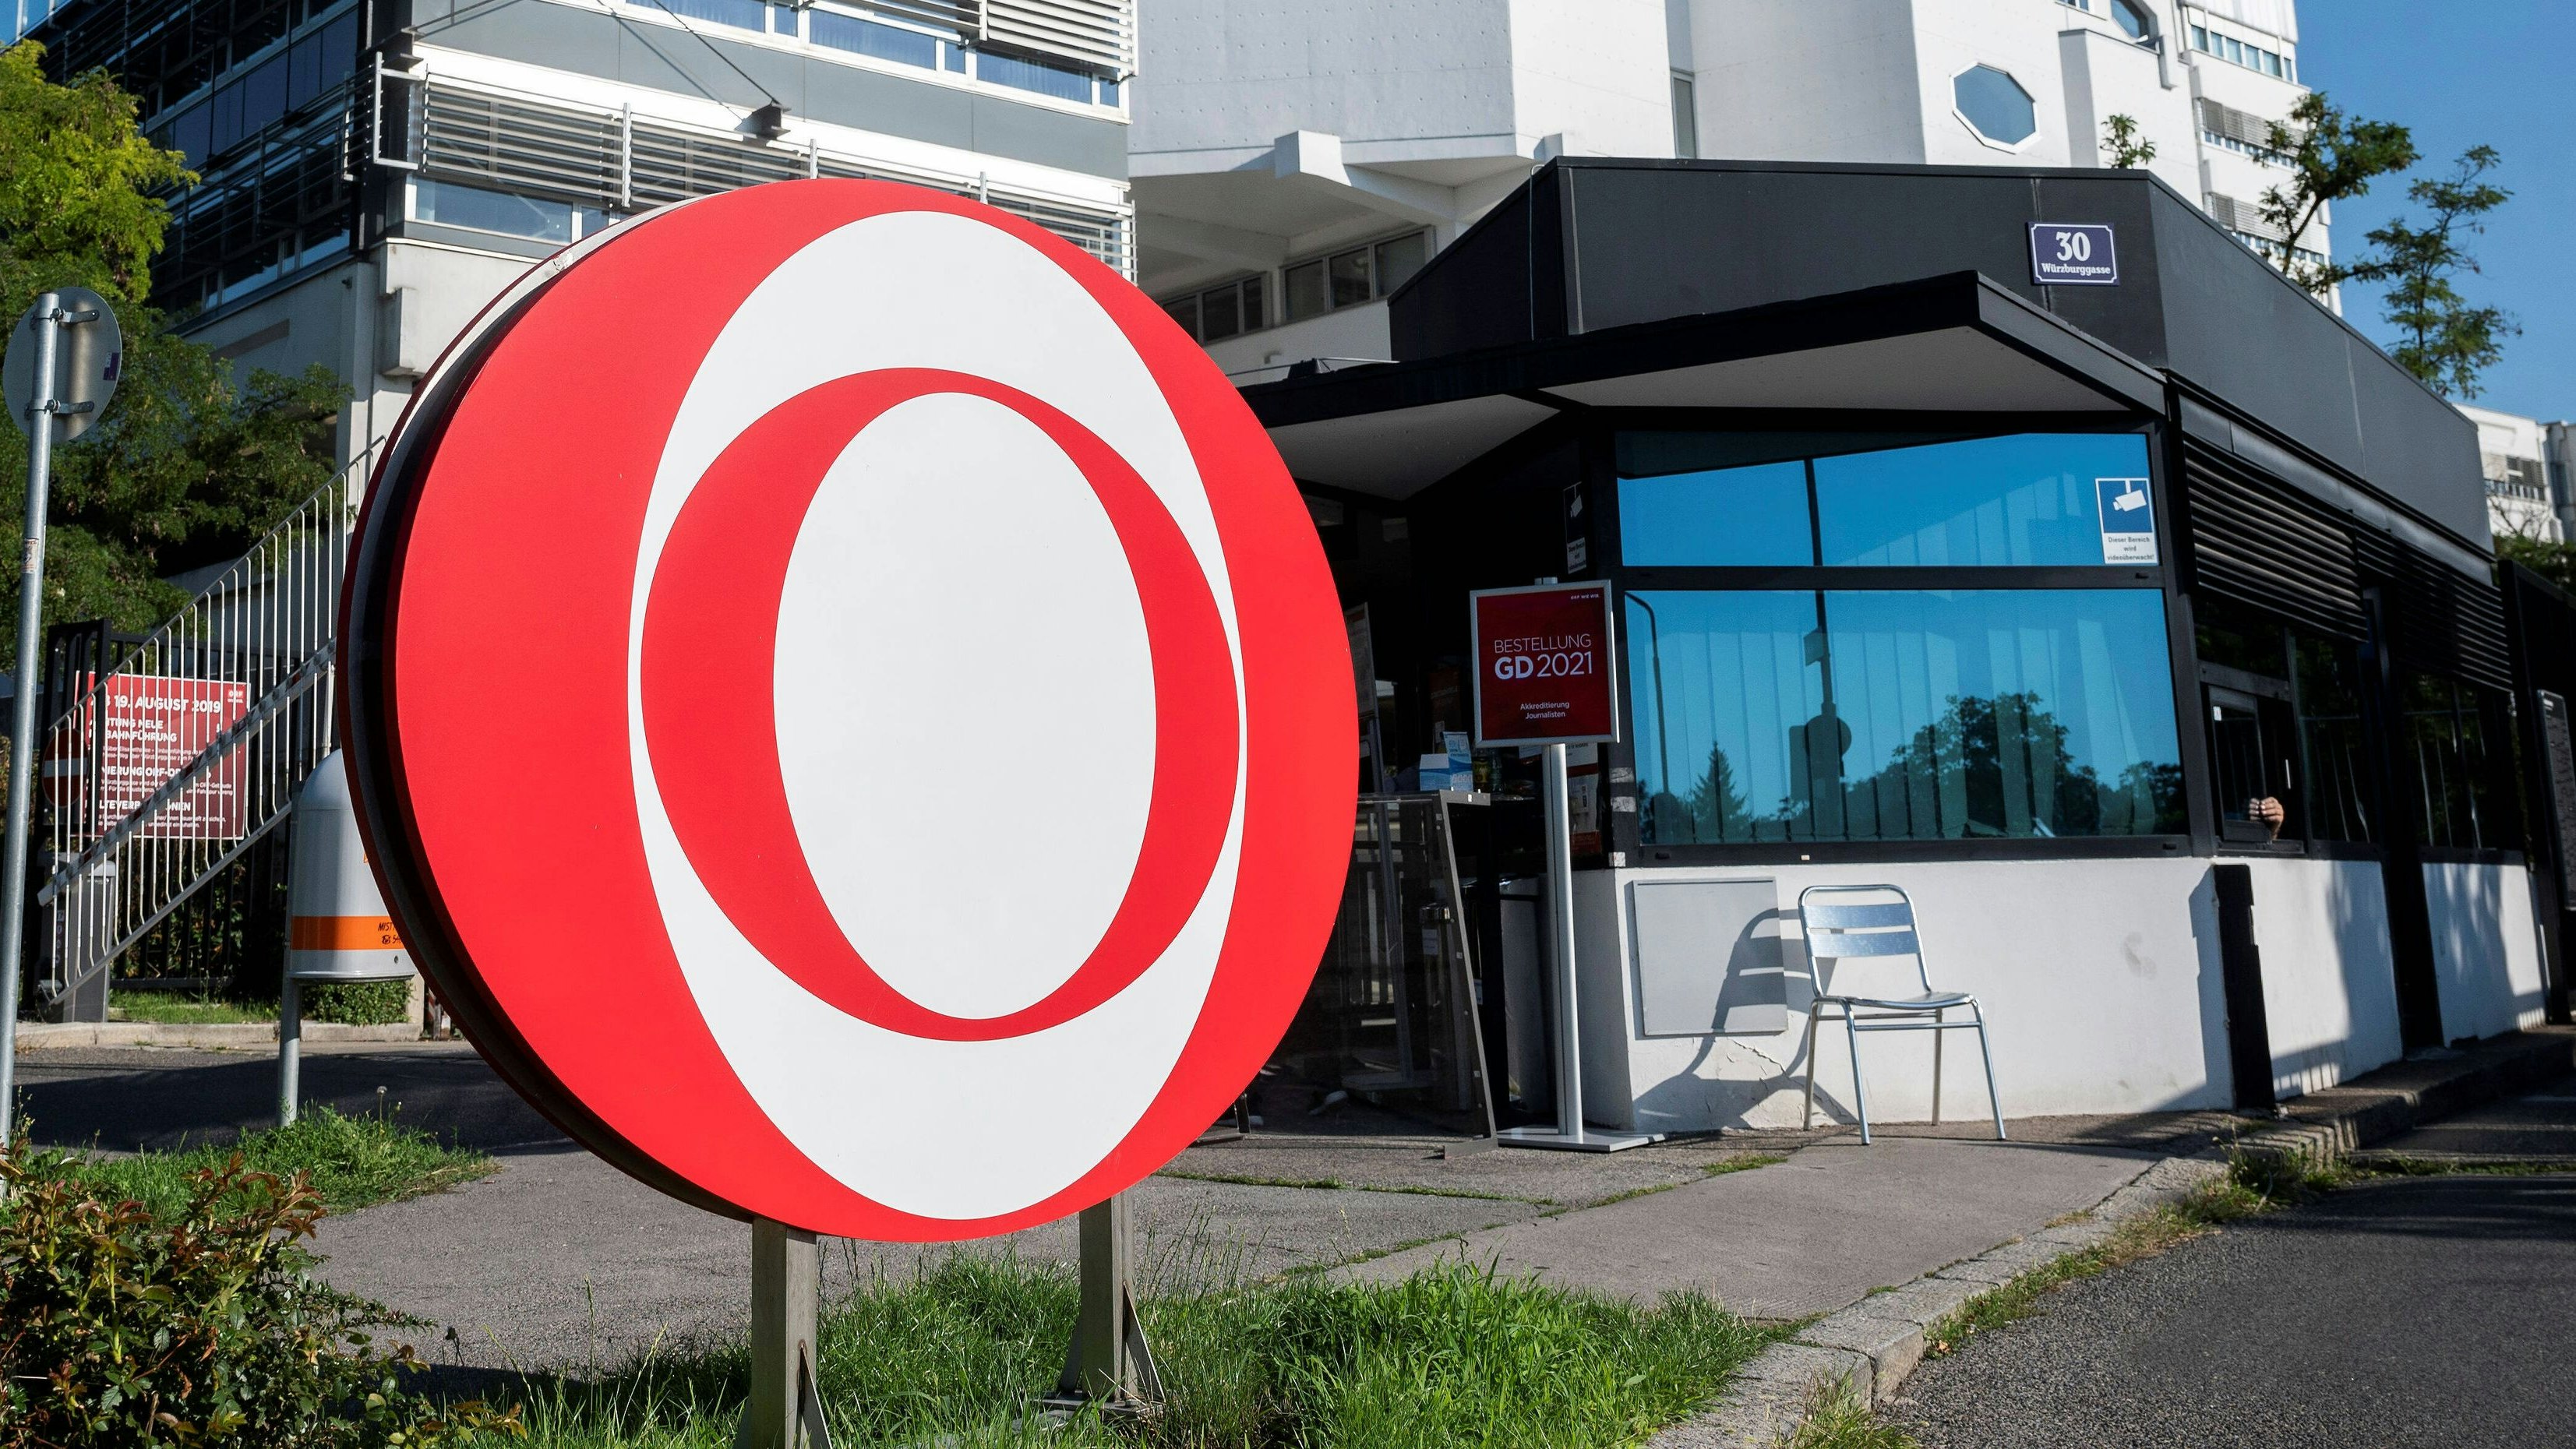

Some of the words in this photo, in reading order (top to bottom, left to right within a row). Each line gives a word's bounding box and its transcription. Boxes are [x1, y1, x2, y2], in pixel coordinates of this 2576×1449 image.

[2056, 231, 2091, 261] 30
[2041, 263, 2111, 276] Würzburggasse
[1494, 633, 1592, 654] BESTELLUNG
[1494, 656, 1533, 680] GD
[1537, 650, 1593, 678] 2021
[114, 695, 131, 708] 19.
[135, 696, 189, 711] AUGUST
[191, 700, 221, 714] 2019
[1520, 701, 1569, 710] Akkreditierung
[1525, 710, 1565, 720] Journalisten
